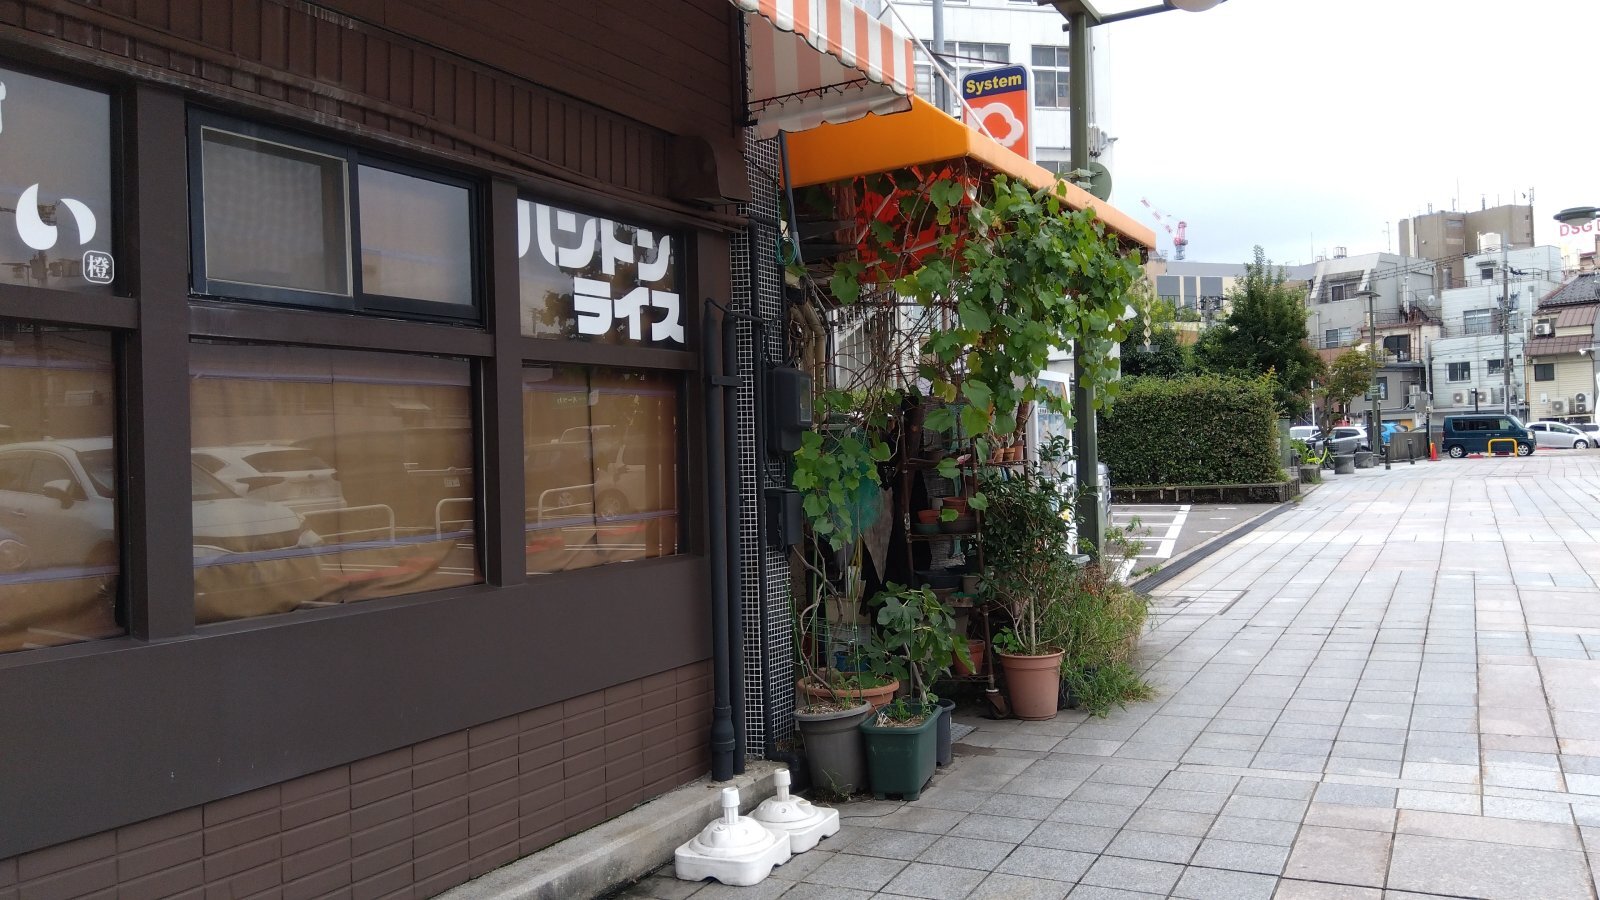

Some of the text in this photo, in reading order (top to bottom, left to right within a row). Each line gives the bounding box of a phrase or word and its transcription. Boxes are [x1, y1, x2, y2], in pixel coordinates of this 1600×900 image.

[966, 75, 1022, 95] System
[16, 183, 97, 250] い
[517, 198, 671, 282] ハントン
[87, 253, 111, 281] 橙
[574, 277, 685, 343] ライス
